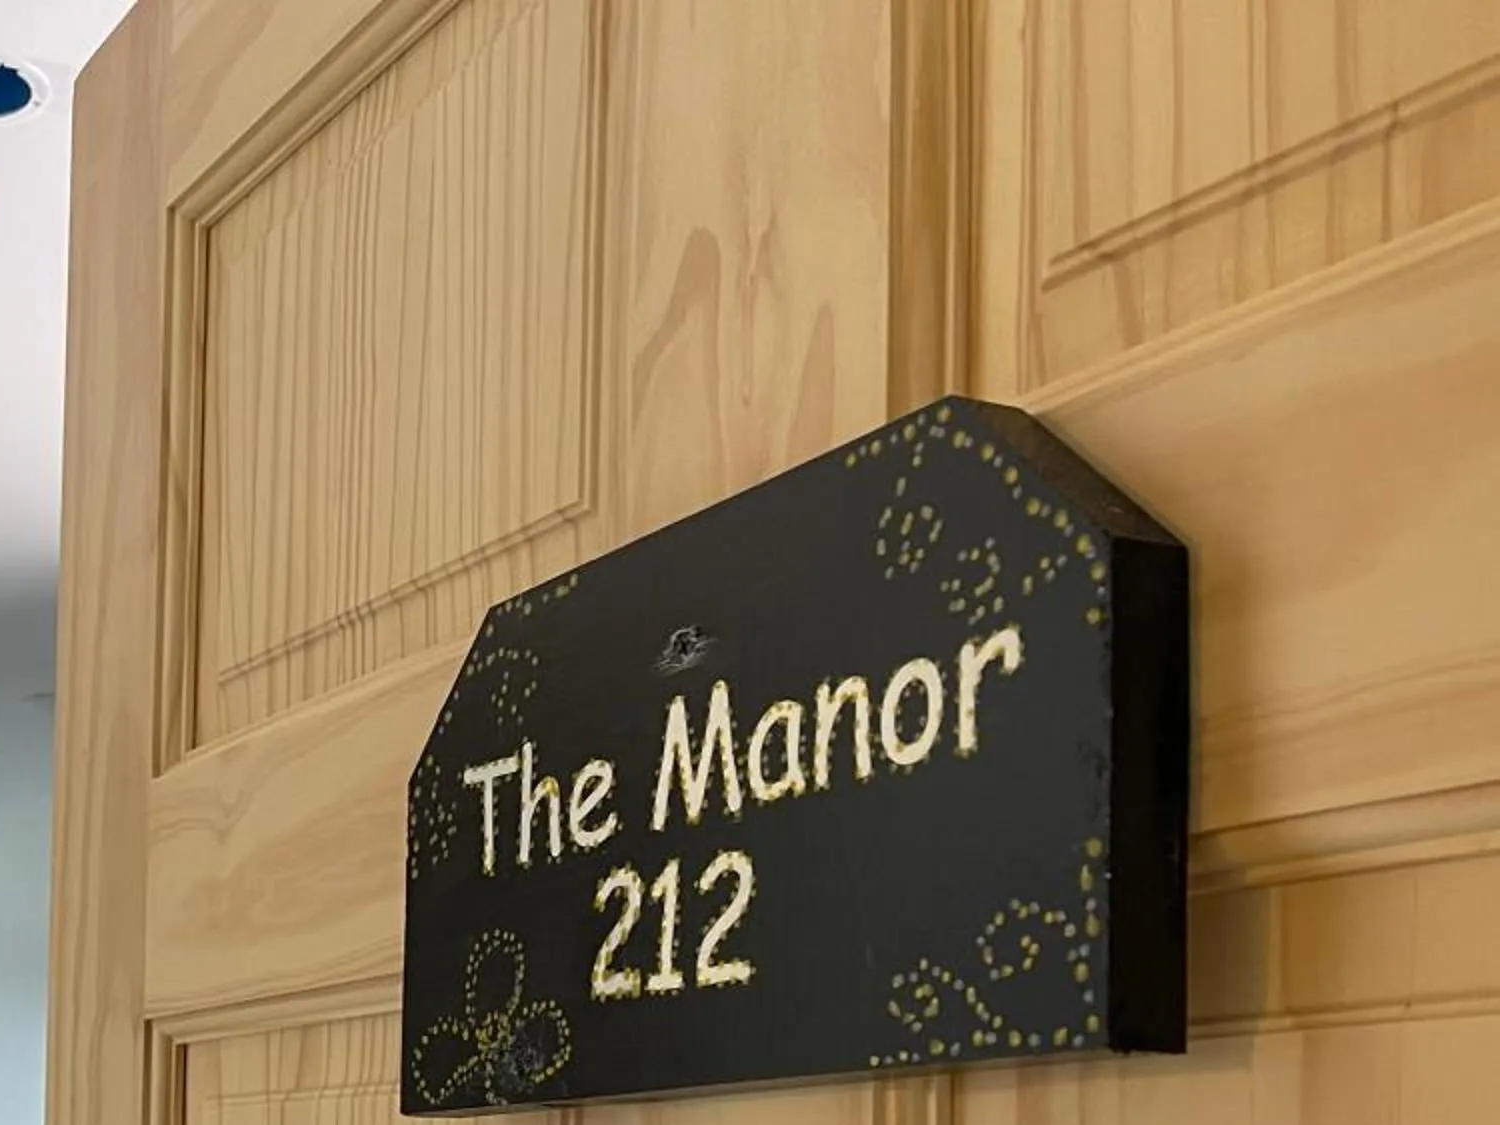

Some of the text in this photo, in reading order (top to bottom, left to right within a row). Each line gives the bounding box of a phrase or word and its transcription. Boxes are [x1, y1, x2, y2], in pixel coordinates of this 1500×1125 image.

[462, 626, 1025, 874] The Manor
[589, 849, 758, 999] 212
